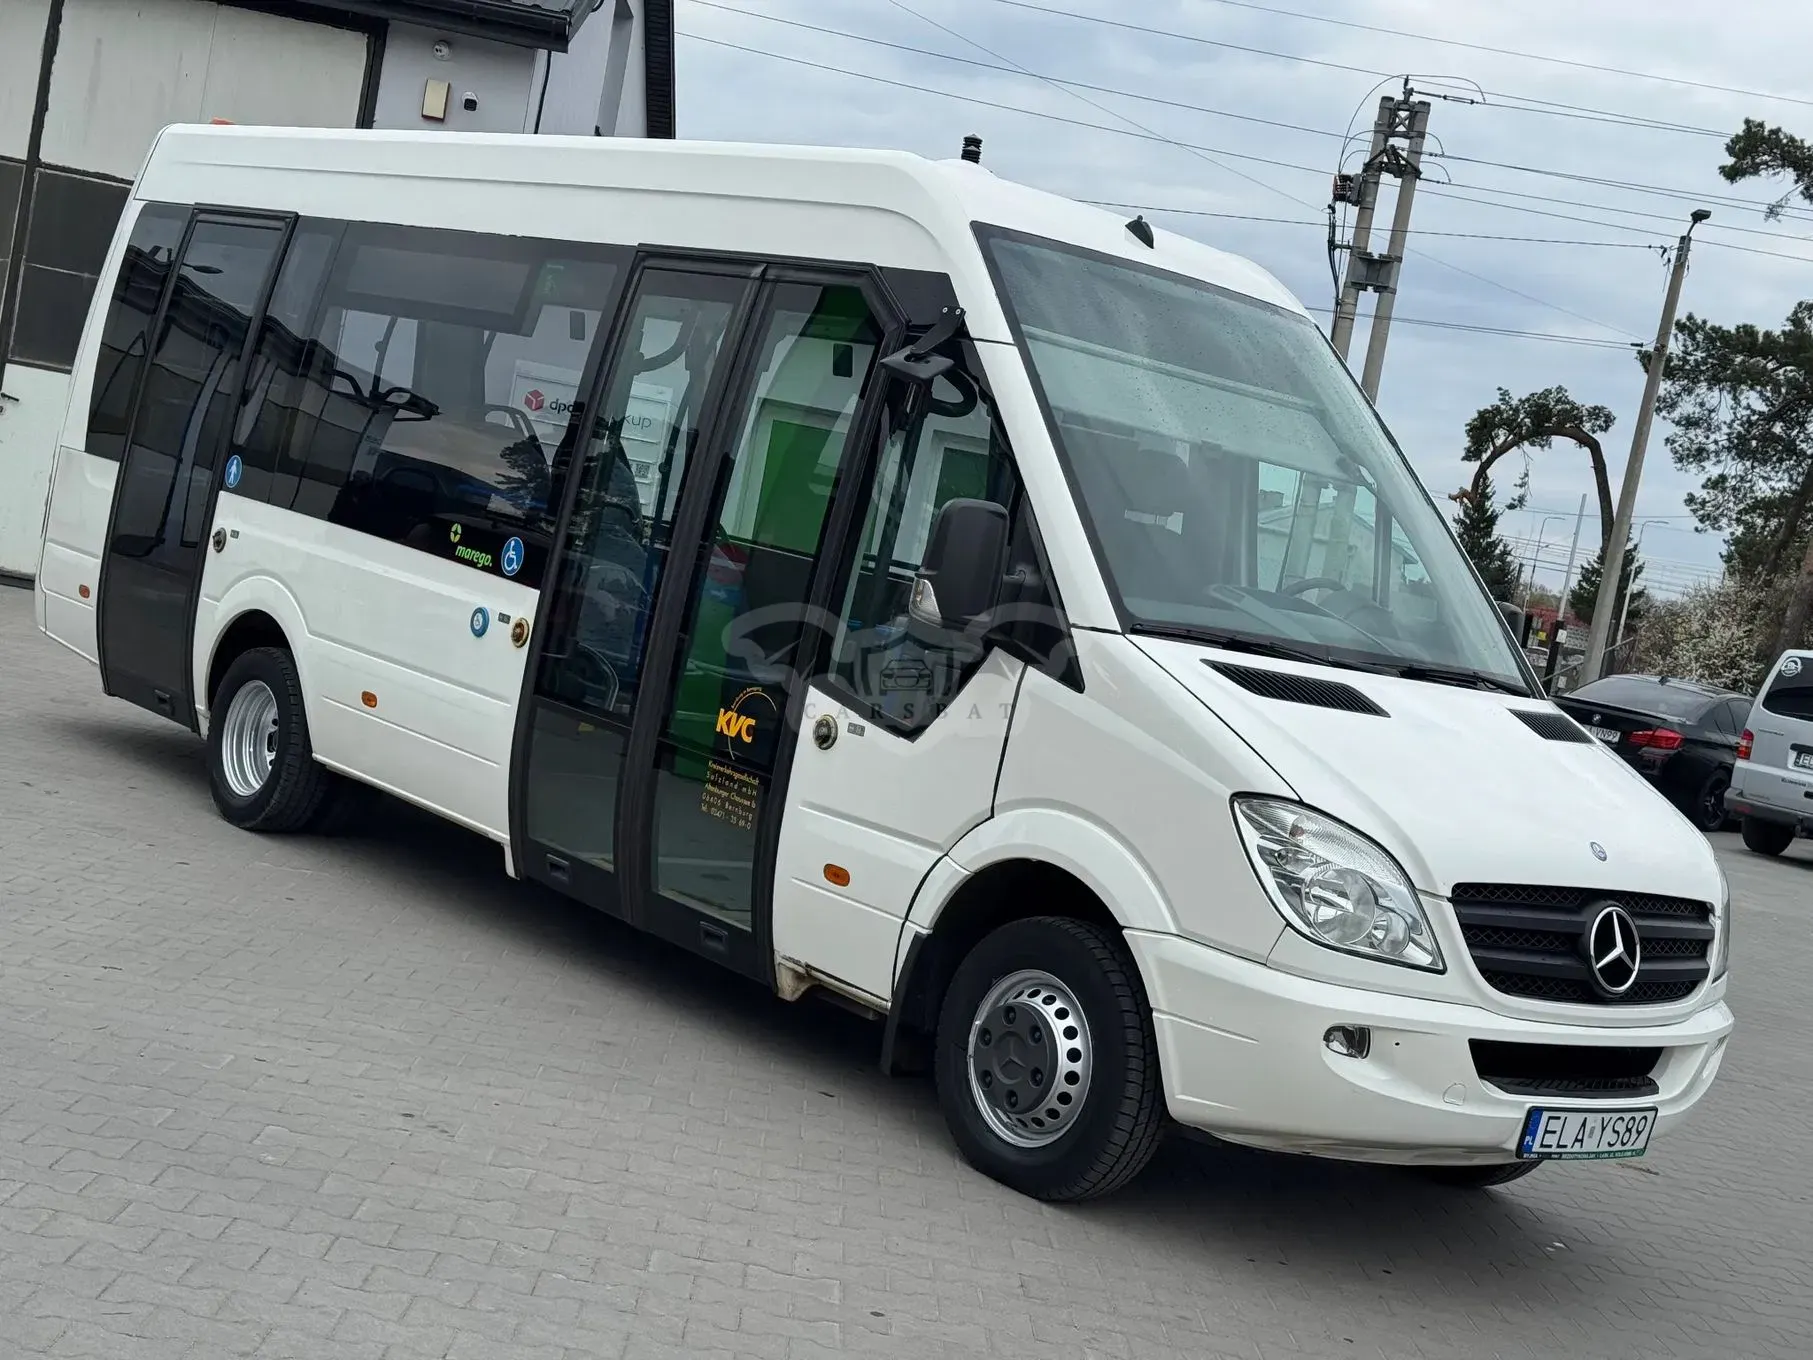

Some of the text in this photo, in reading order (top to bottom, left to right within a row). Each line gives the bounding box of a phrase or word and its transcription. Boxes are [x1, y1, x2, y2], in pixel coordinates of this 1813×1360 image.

[1524, 1136, 1533, 1146] PL
[1538, 1115, 1649, 1149] ELA YS89
